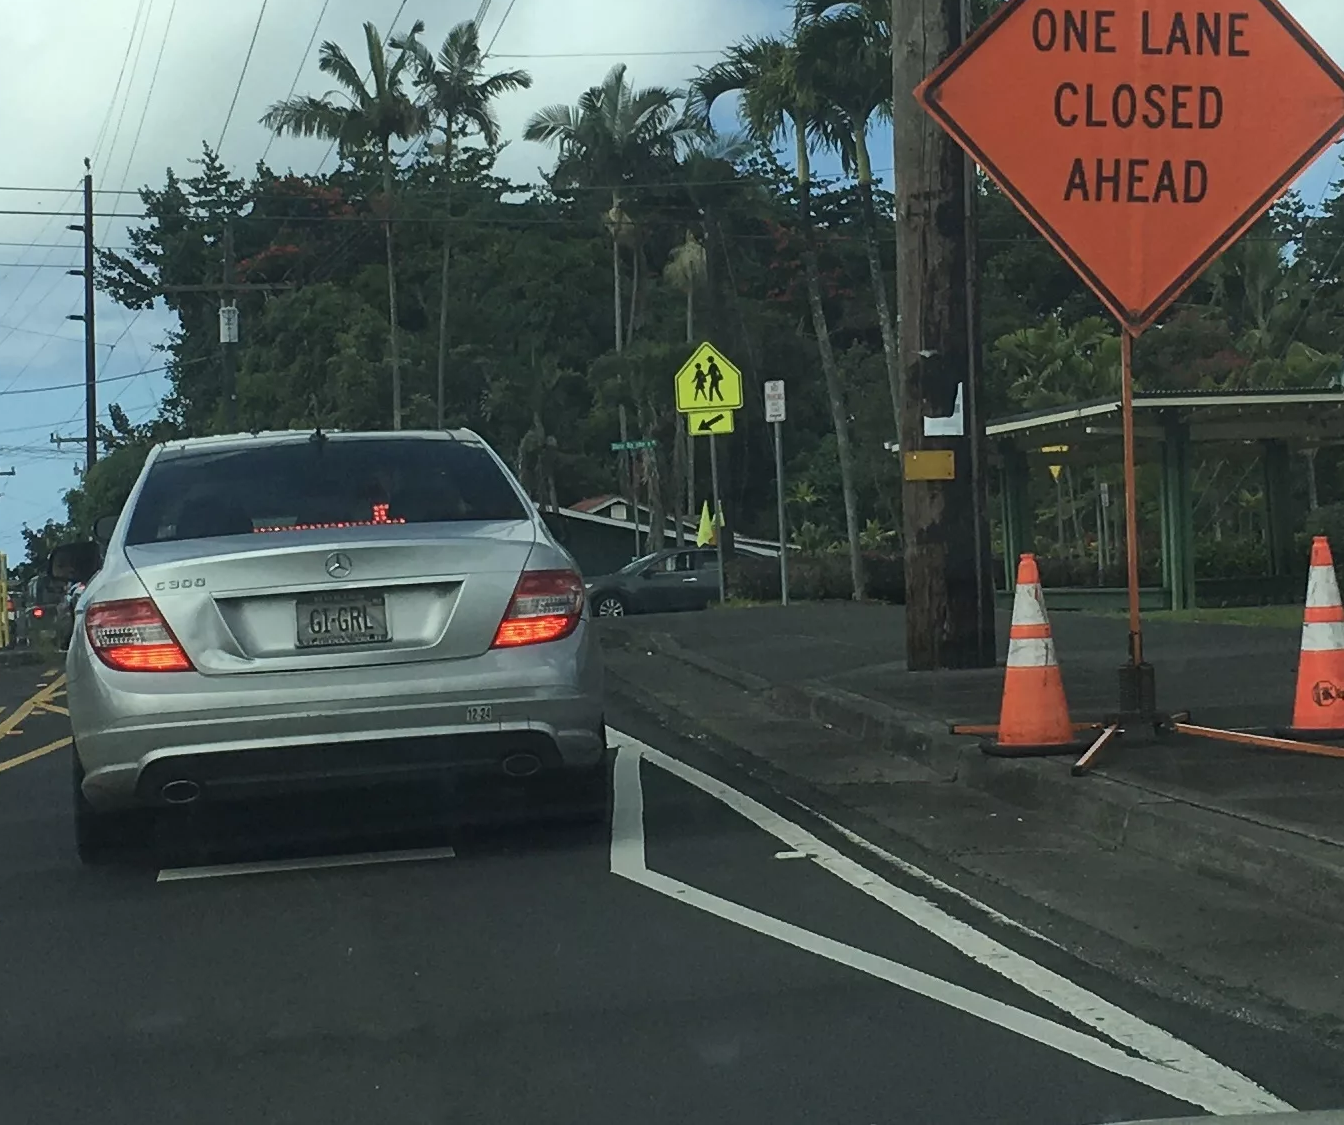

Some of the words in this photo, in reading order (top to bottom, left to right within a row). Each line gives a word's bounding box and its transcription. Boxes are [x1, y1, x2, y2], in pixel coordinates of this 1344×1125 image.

[1032, 8, 1116, 53] ONE
[1142, 10, 1250, 57] LANE
[1054, 82, 1224, 129] CLOSED
[1063, 157, 1208, 204] AHEAD
